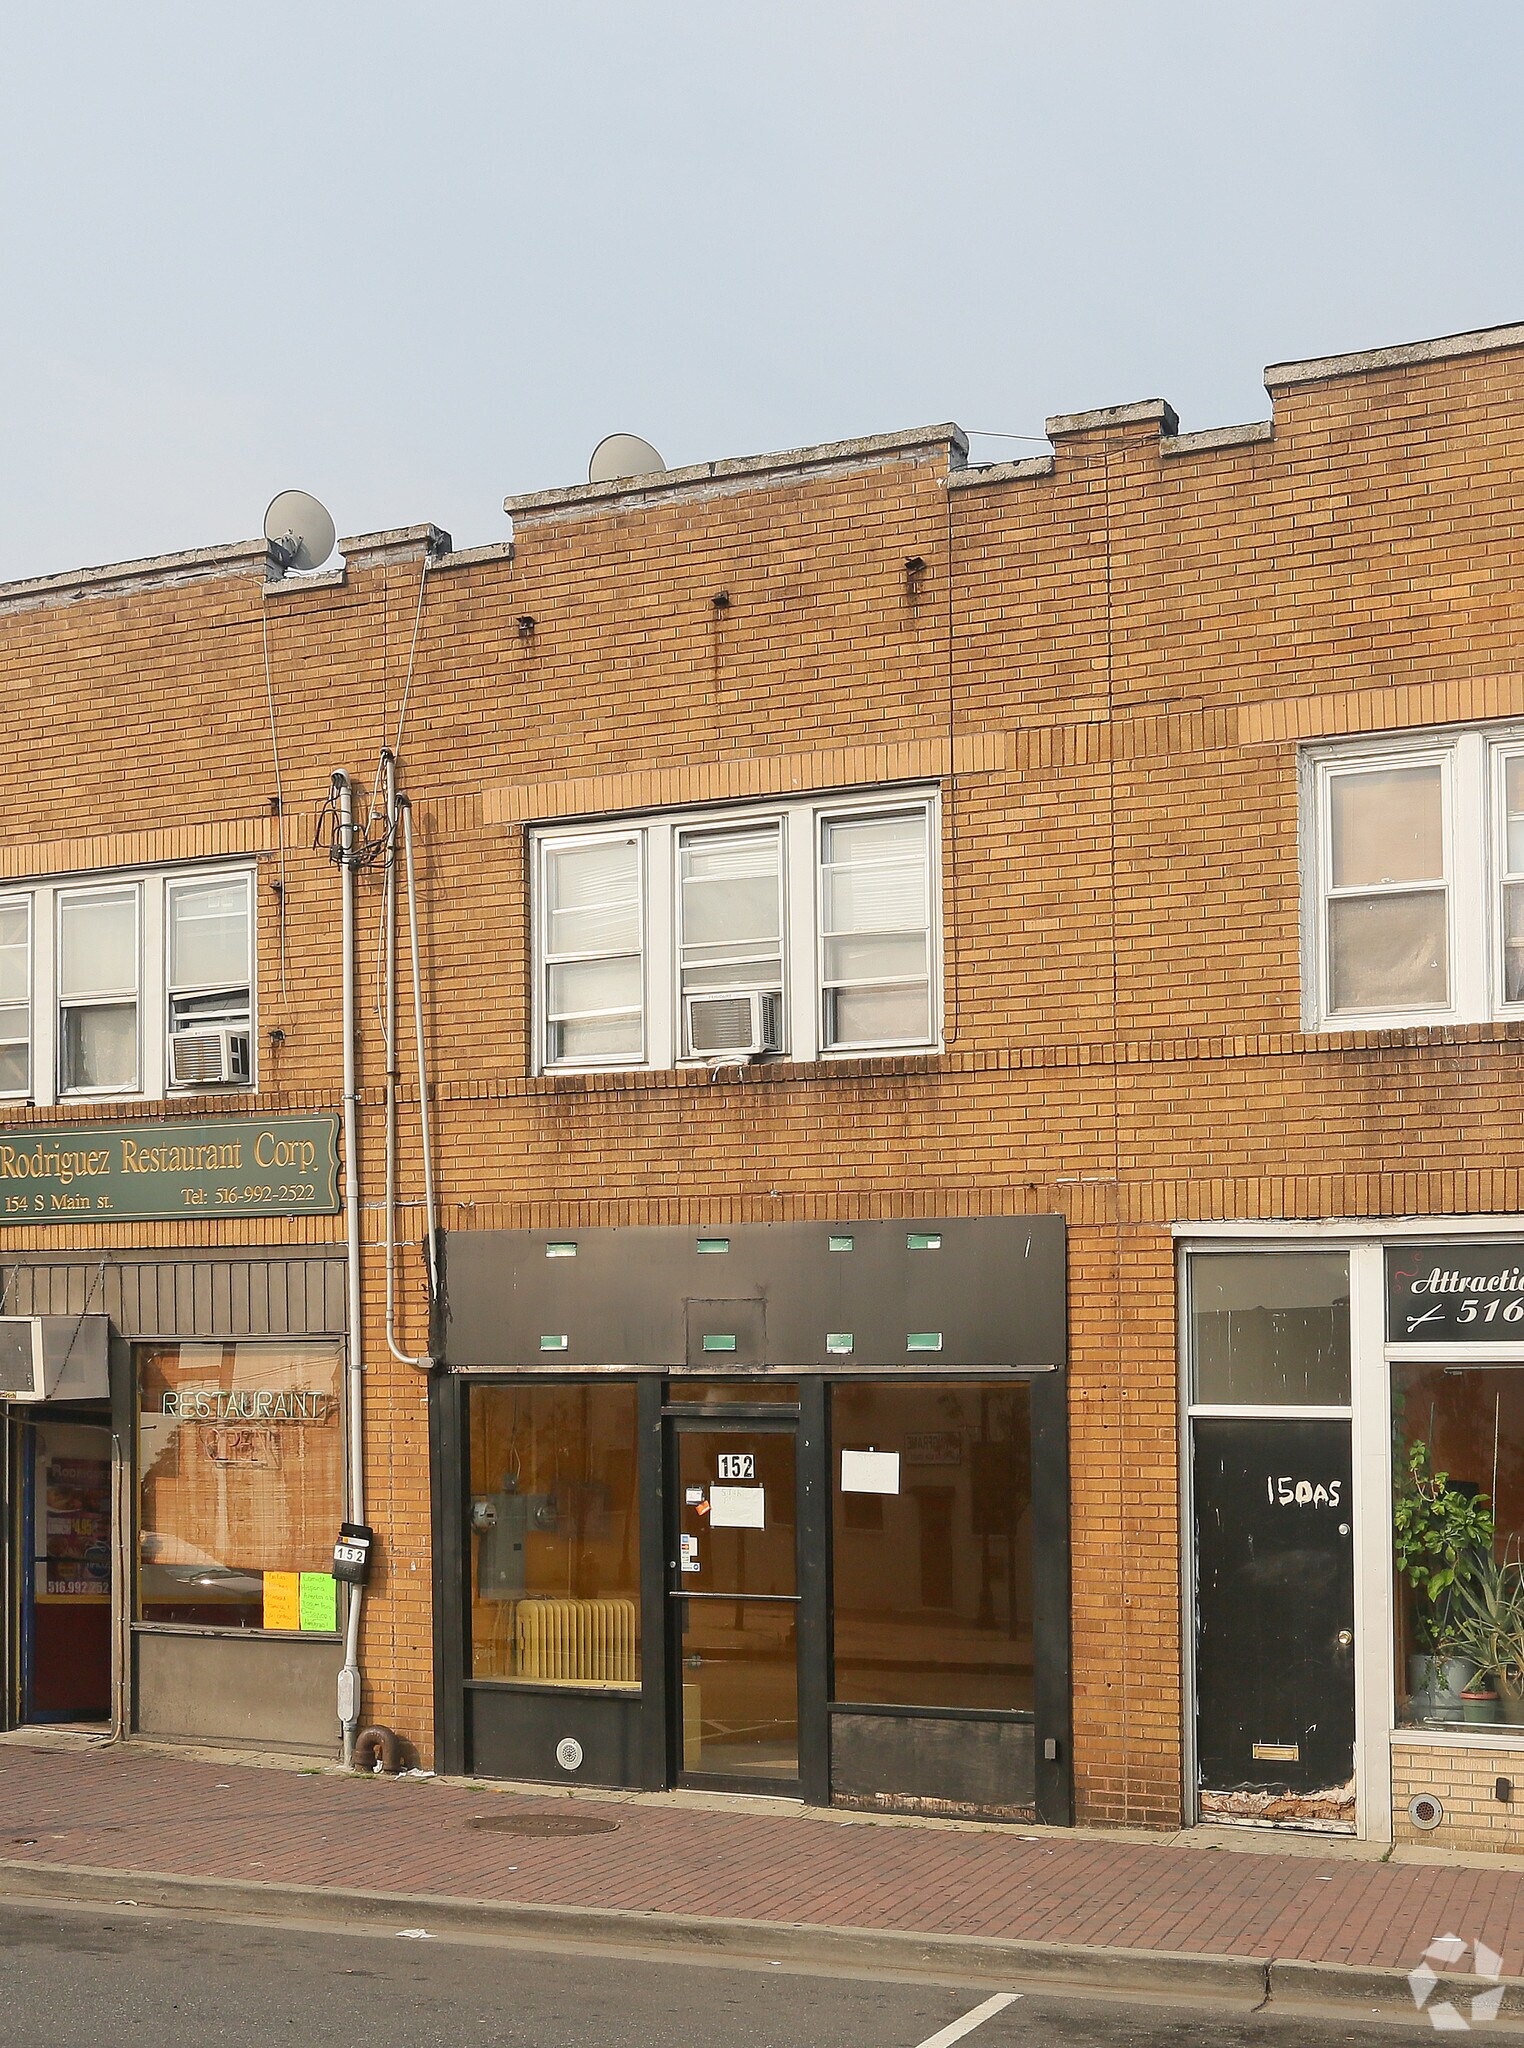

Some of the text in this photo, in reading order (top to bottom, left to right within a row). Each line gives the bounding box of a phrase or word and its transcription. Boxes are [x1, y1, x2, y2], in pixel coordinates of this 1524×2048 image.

[0, 1131, 319, 1185] Rodriguez Restaurant Corp.
[5, 1193, 114, 1213] 154 S Main st.
[181, 1184, 315, 1205] Tel: 516-992-2522
[1456, 1297, 1524, 1323] 516
[162, 1391, 325, 1418] RESTAURANT
[721, 1456, 753, 1477] 152
[338, 1548, 363, 1562] 152
